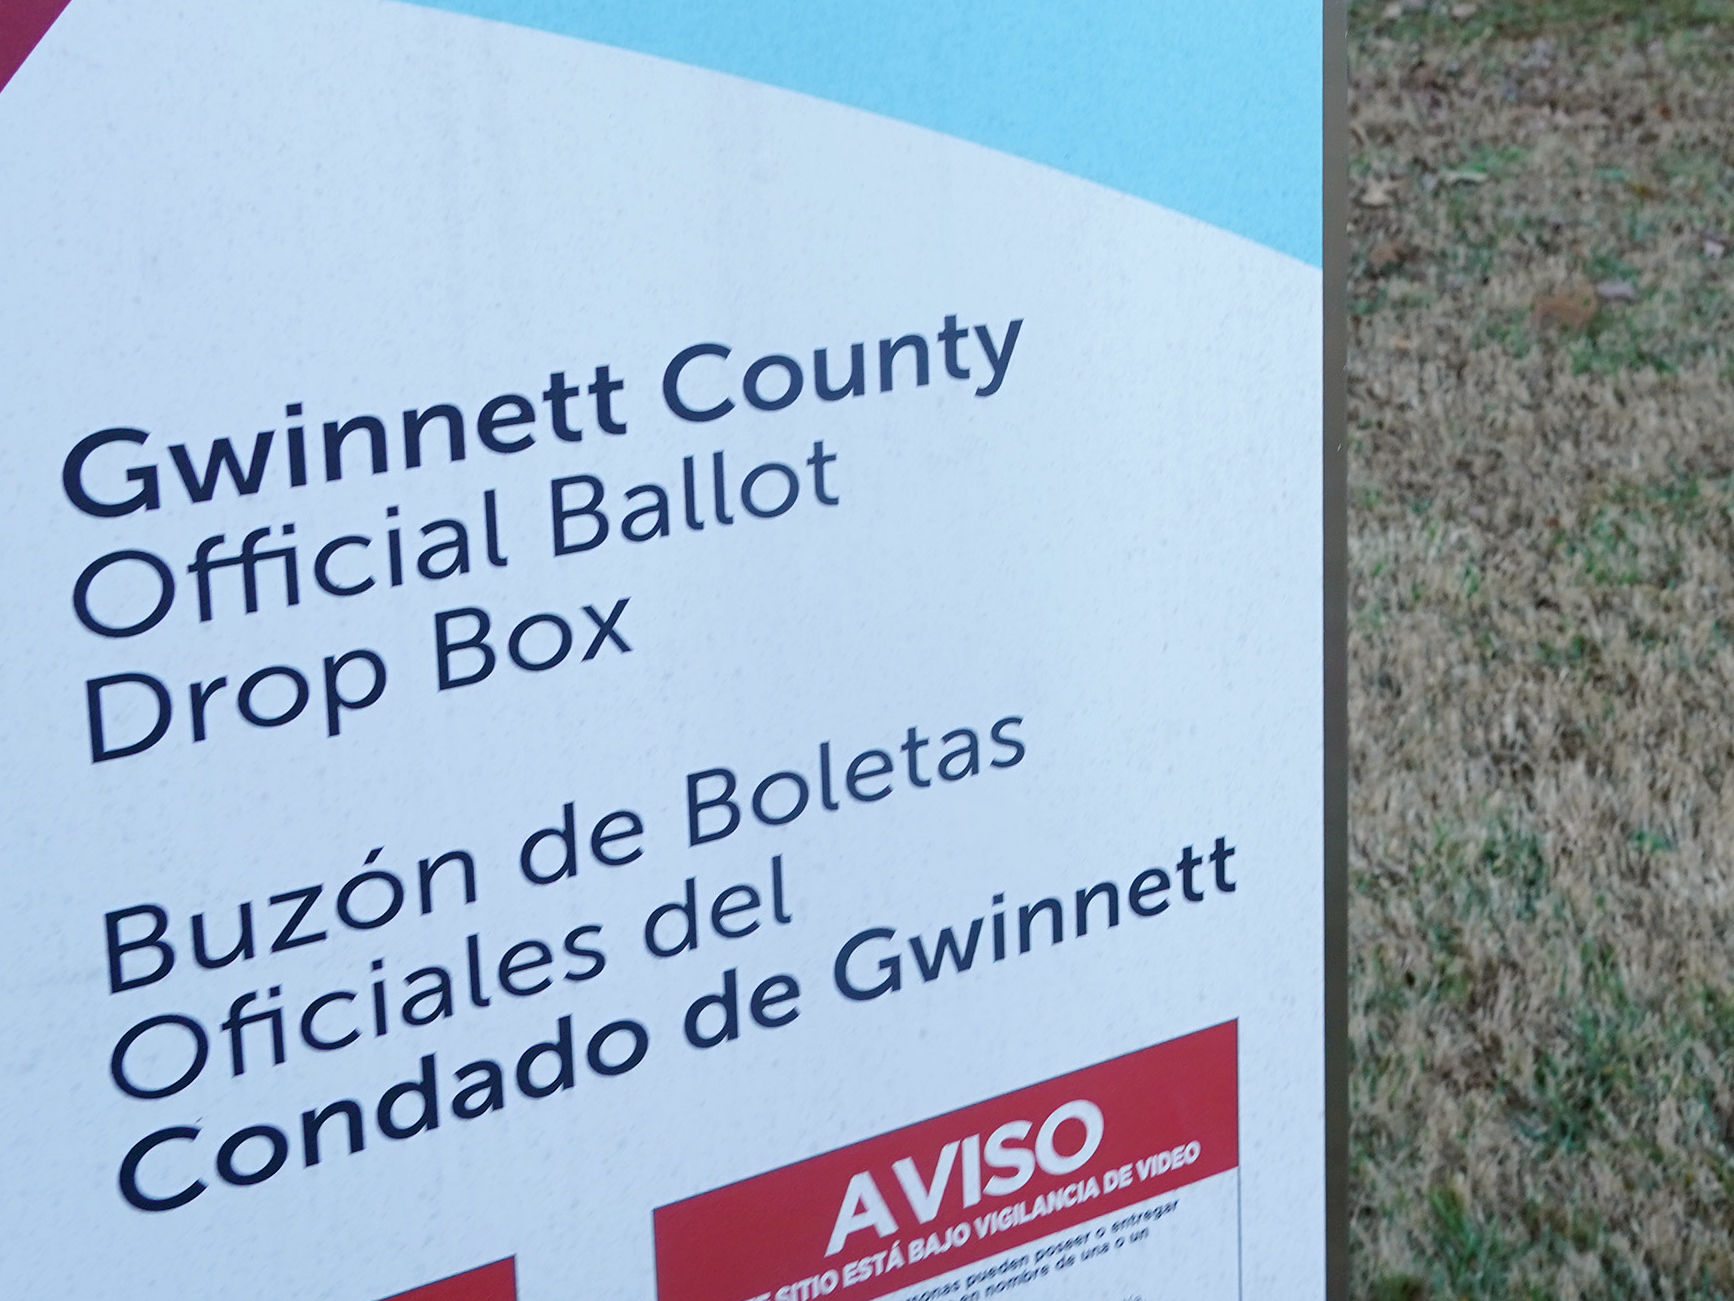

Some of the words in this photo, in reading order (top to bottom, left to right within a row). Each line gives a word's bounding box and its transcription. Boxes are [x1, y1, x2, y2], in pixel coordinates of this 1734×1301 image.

[61, 364, 628, 519] Gwinnett
[662, 314, 1025, 423] County
[72, 488, 509, 640] Official
[550, 440, 841, 558] Ballot
[85, 648, 388, 765] Drop
[434, 597, 633, 692] Box
[103, 846, 478, 996] Buzón
[519, 801, 645, 886] de
[686, 716, 1027, 848] Boletas
[109, 924, 607, 1102] Oficiales
[643, 854, 792, 959] del
[117, 1013, 650, 1214] Condado
[683, 967, 802, 1050] de
[833, 835, 1237, 1002] Gwinnett
[824, 1099, 1105, 1258] AVISO
[842, 1239, 905, 1288] ESTÁ
[908, 1220, 971, 1265] BAJO
[974, 1176, 1101, 1240] VIGILANCIA
[1103, 1163, 1133, 1194] DE
[1135, 1140, 1202, 1182] VIDEO
[966, 1255, 1029, 1290] pueden
[1034, 1230, 1092, 1265] poseer
[1095, 1226, 1107, 1239] o
[1111, 1199, 1179, 1234] entregar
[985, 1263, 1049, 1298] nombre
[1055, 1253, 1076, 1271] de
[1080, 1241, 1110, 1262] una
[1114, 1236, 1126, 1249] o
[1129, 1226, 1150, 1242] un
